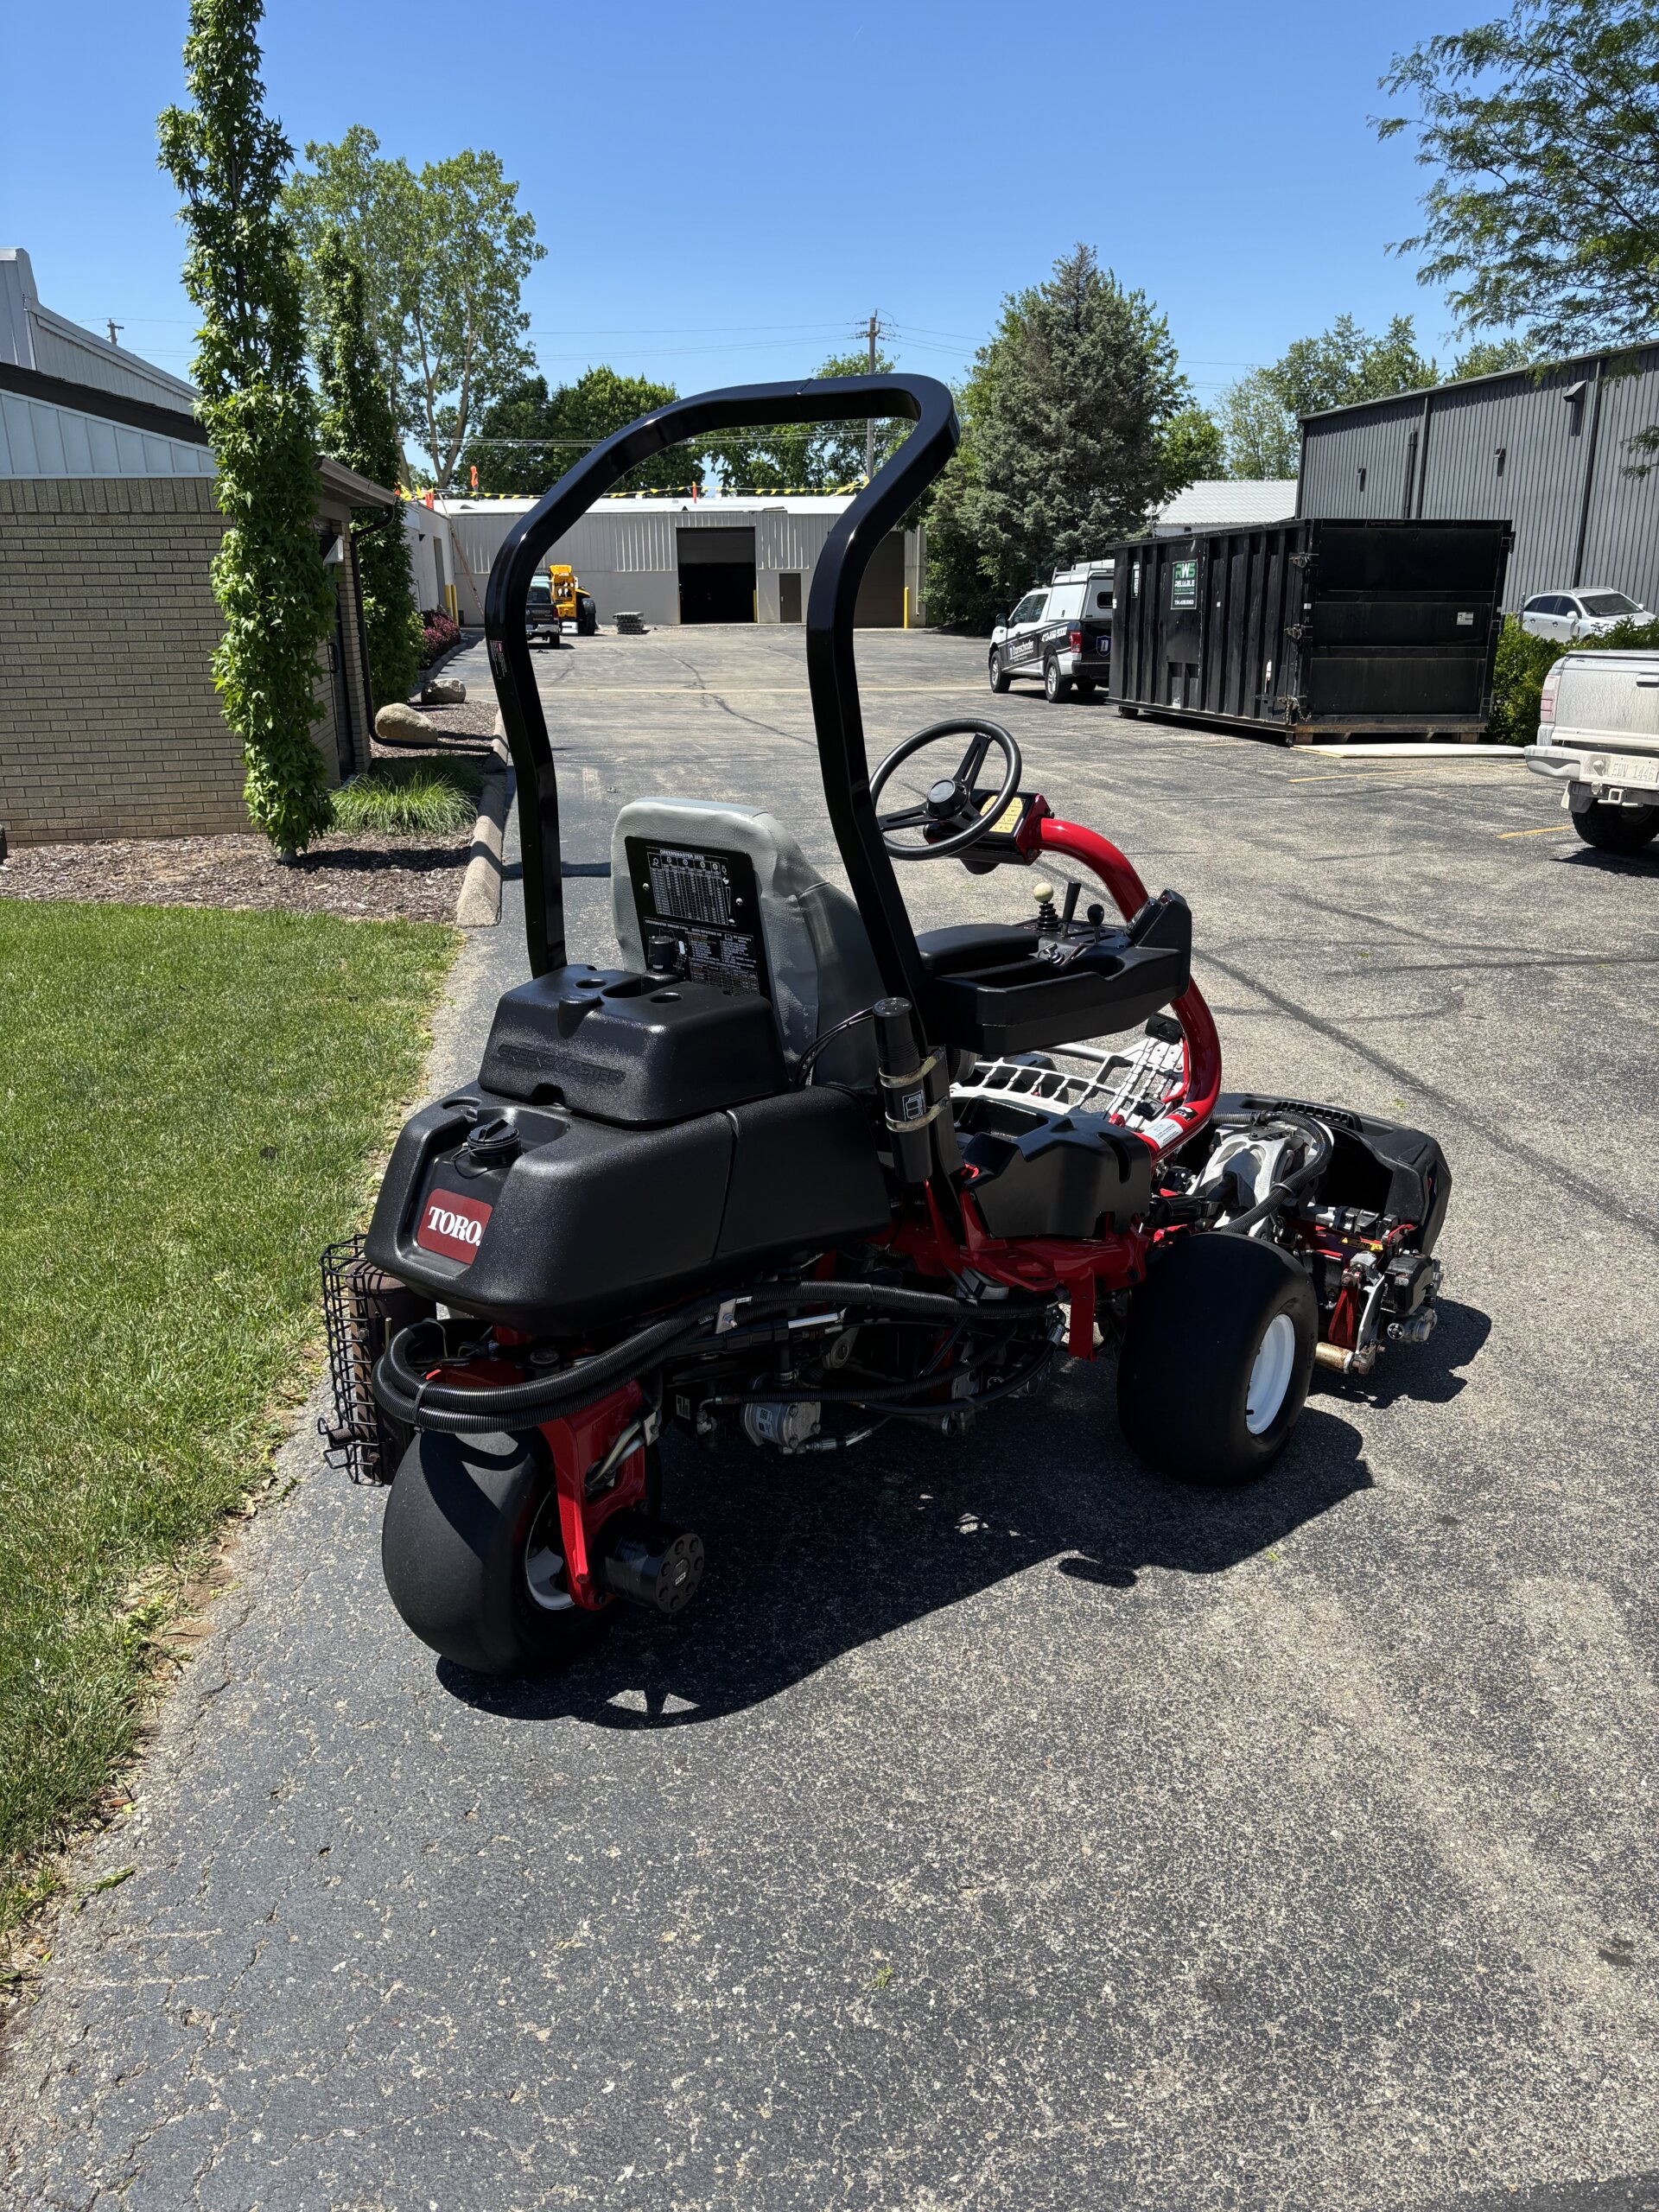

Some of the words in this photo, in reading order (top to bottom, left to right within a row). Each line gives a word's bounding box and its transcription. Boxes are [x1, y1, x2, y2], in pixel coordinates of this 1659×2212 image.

[1176, 563, 1196, 578] RWS
[1100, 639, 1109, 652] D
[1632, 765, 1656, 779] 1446
